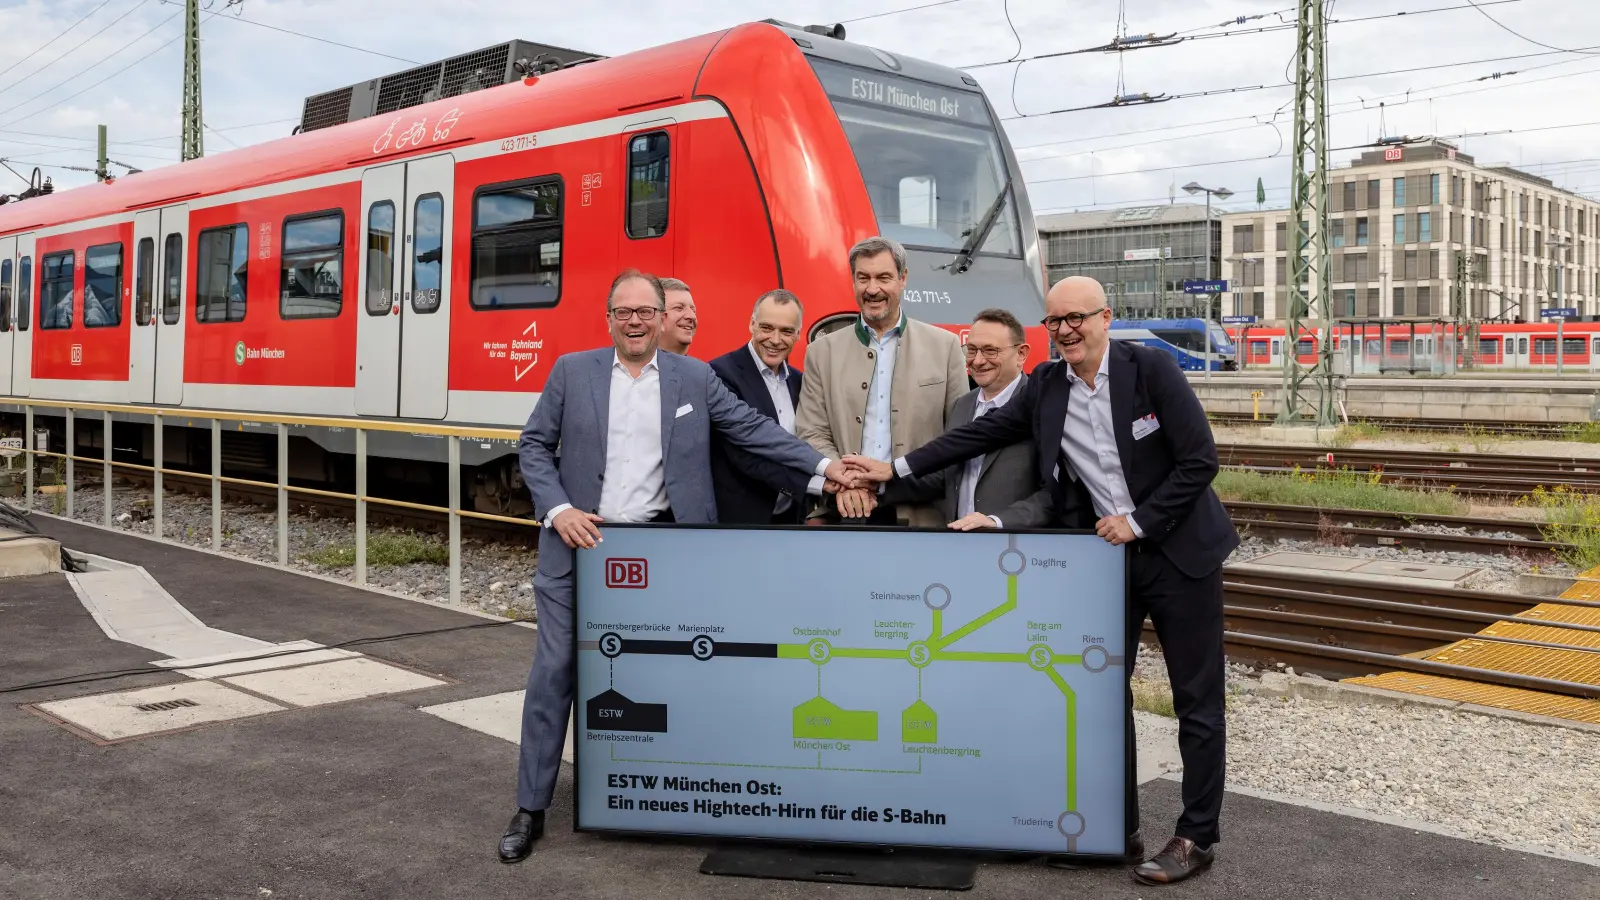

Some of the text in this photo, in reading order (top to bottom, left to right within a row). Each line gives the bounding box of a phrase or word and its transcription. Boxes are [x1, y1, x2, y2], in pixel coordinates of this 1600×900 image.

[852, 78, 959, 117] ESTW München Ost
[501, 134, 537, 151] 423 771-5
[1386, 150, 1402, 160] DB
[903, 289, 951, 304] 423 771-5
[511, 339, 543, 349] Bahnland
[72, 346, 82, 363] DB
[246, 347, 260, 359] Bahn
[260, 347, 285, 359] München
[496, 350, 506, 358] das
[510, 350, 532, 362] Bayern
[609, 561, 645, 586] DB
[870, 591, 921, 601] Steinhausen
[586, 621, 671, 632] Donnersbergerbrücke
[678, 623, 725, 634] Marienplatz
[874, 619, 915, 629] Leuchten-
[1027, 620, 1062, 631] Berg am
[793, 626, 842, 637] Ostbahnhof
[874, 629, 909, 639] bergring
[1027, 632, 1048, 642] Laim
[1082, 634, 1105, 644] Riem
[605, 637, 617, 653] S
[697, 640, 709, 655] S
[598, 708, 624, 718] ESTW
[587, 732, 654, 743] Betriebszentrale
[793, 740, 851, 751] München Ost
[902, 744, 981, 757] Leuchtenbergring
[607, 774, 782, 795] ESTW München Ost:
[607, 795, 946, 826] Ein neues Hightech-Hirn für die S-Bahn
[1012, 816, 1054, 828] Trudering
